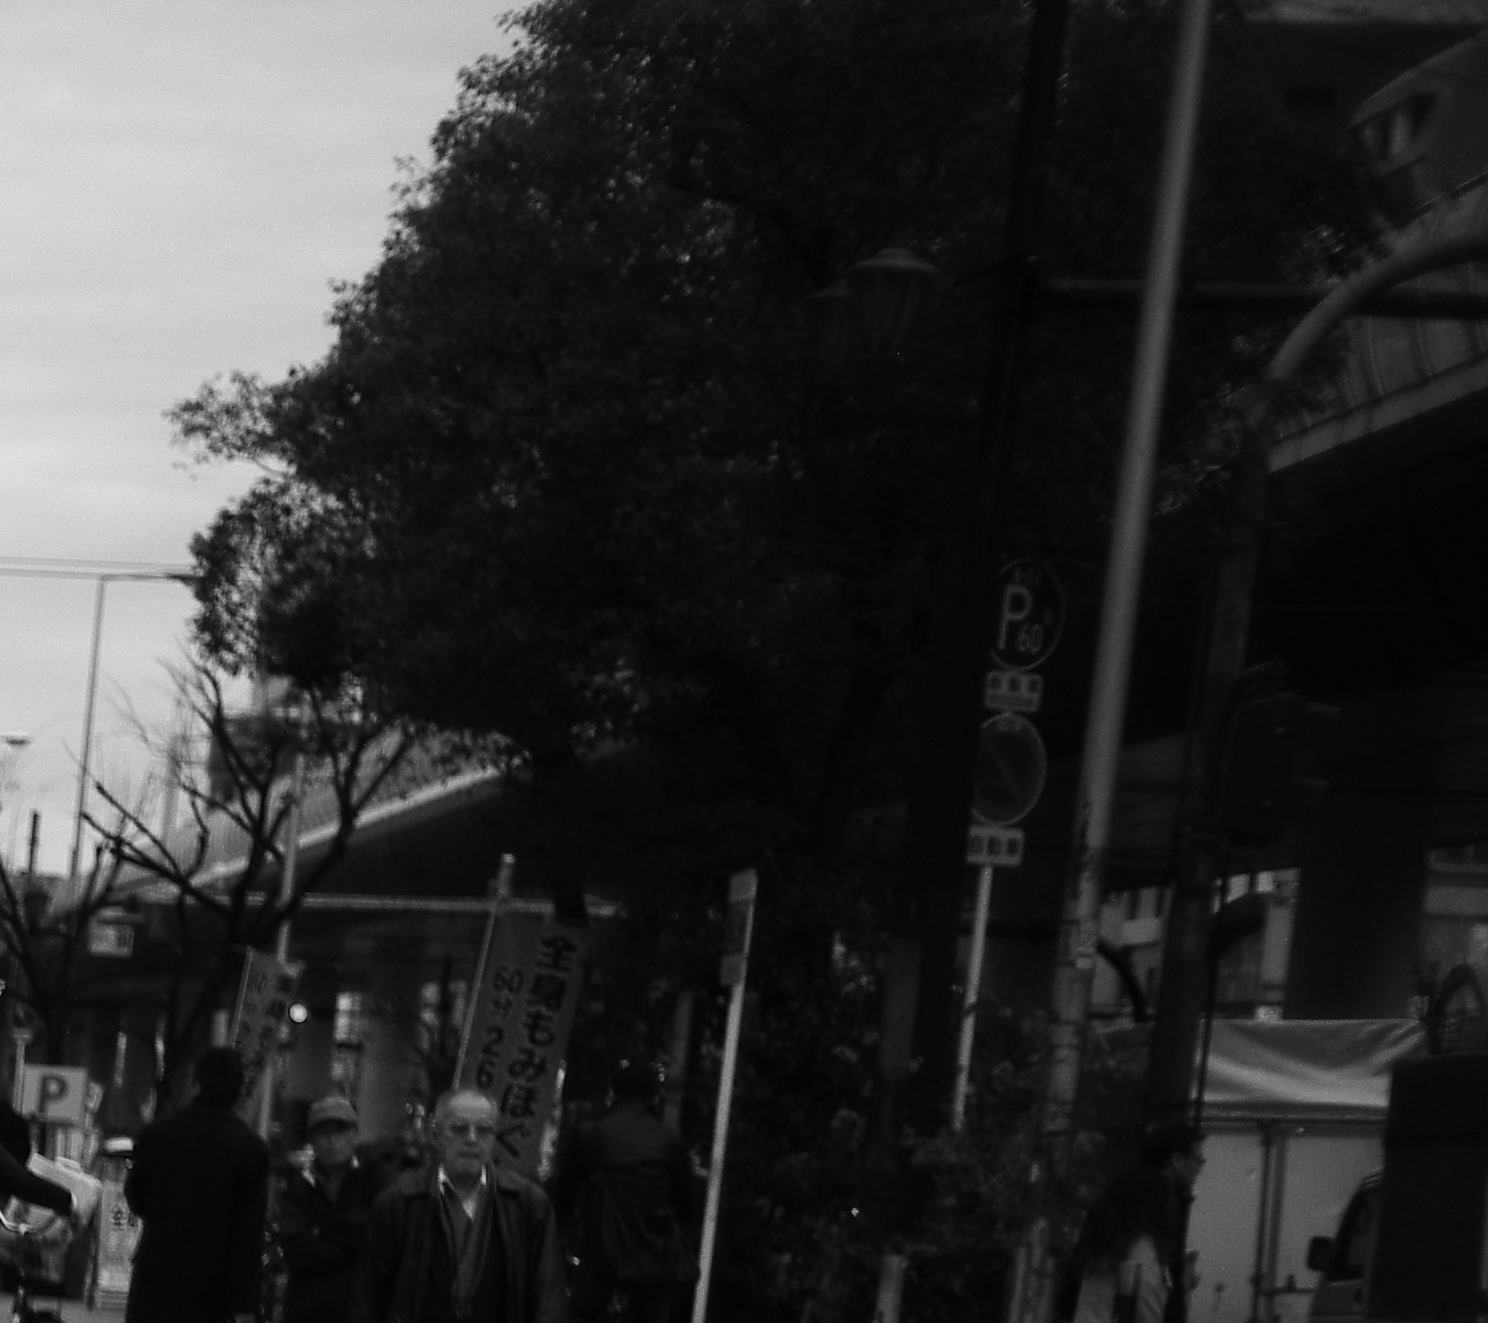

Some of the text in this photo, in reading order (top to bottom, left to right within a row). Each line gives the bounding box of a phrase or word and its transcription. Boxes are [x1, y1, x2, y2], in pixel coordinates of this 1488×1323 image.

[997, 583, 1034, 650] P
[494, 934, 577, 1165] 全身もみほぐ
[39, 1075, 68, 1114] P
